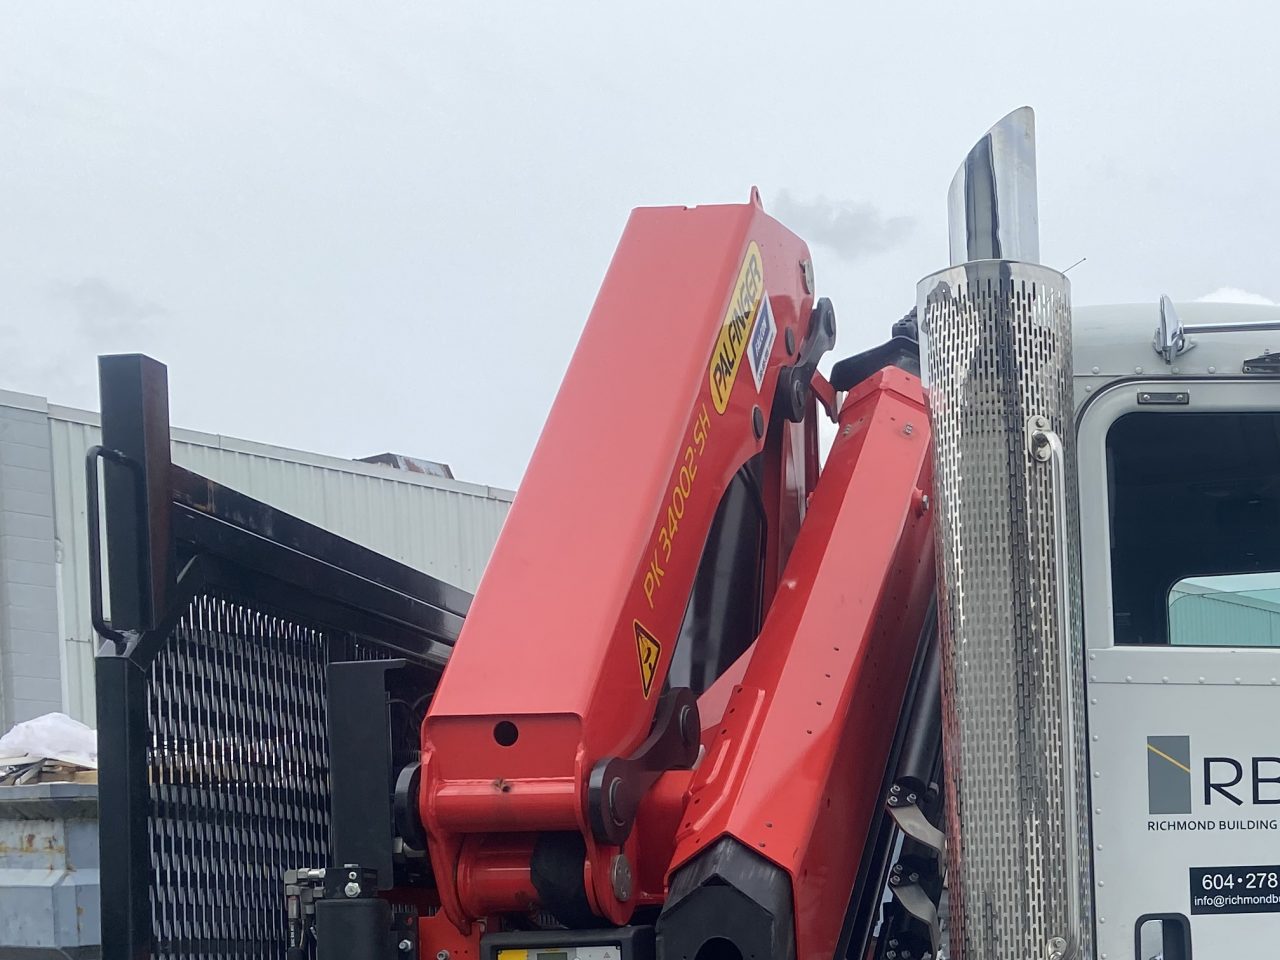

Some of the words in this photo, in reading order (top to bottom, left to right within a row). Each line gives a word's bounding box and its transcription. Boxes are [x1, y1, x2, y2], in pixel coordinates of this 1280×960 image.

[713, 254, 761, 404] PALFINGER
[643, 548, 664, 609] PK
[1147, 820, 1216, 831] RICHMOND
[1219, 820, 1278, 830] BUILDING
